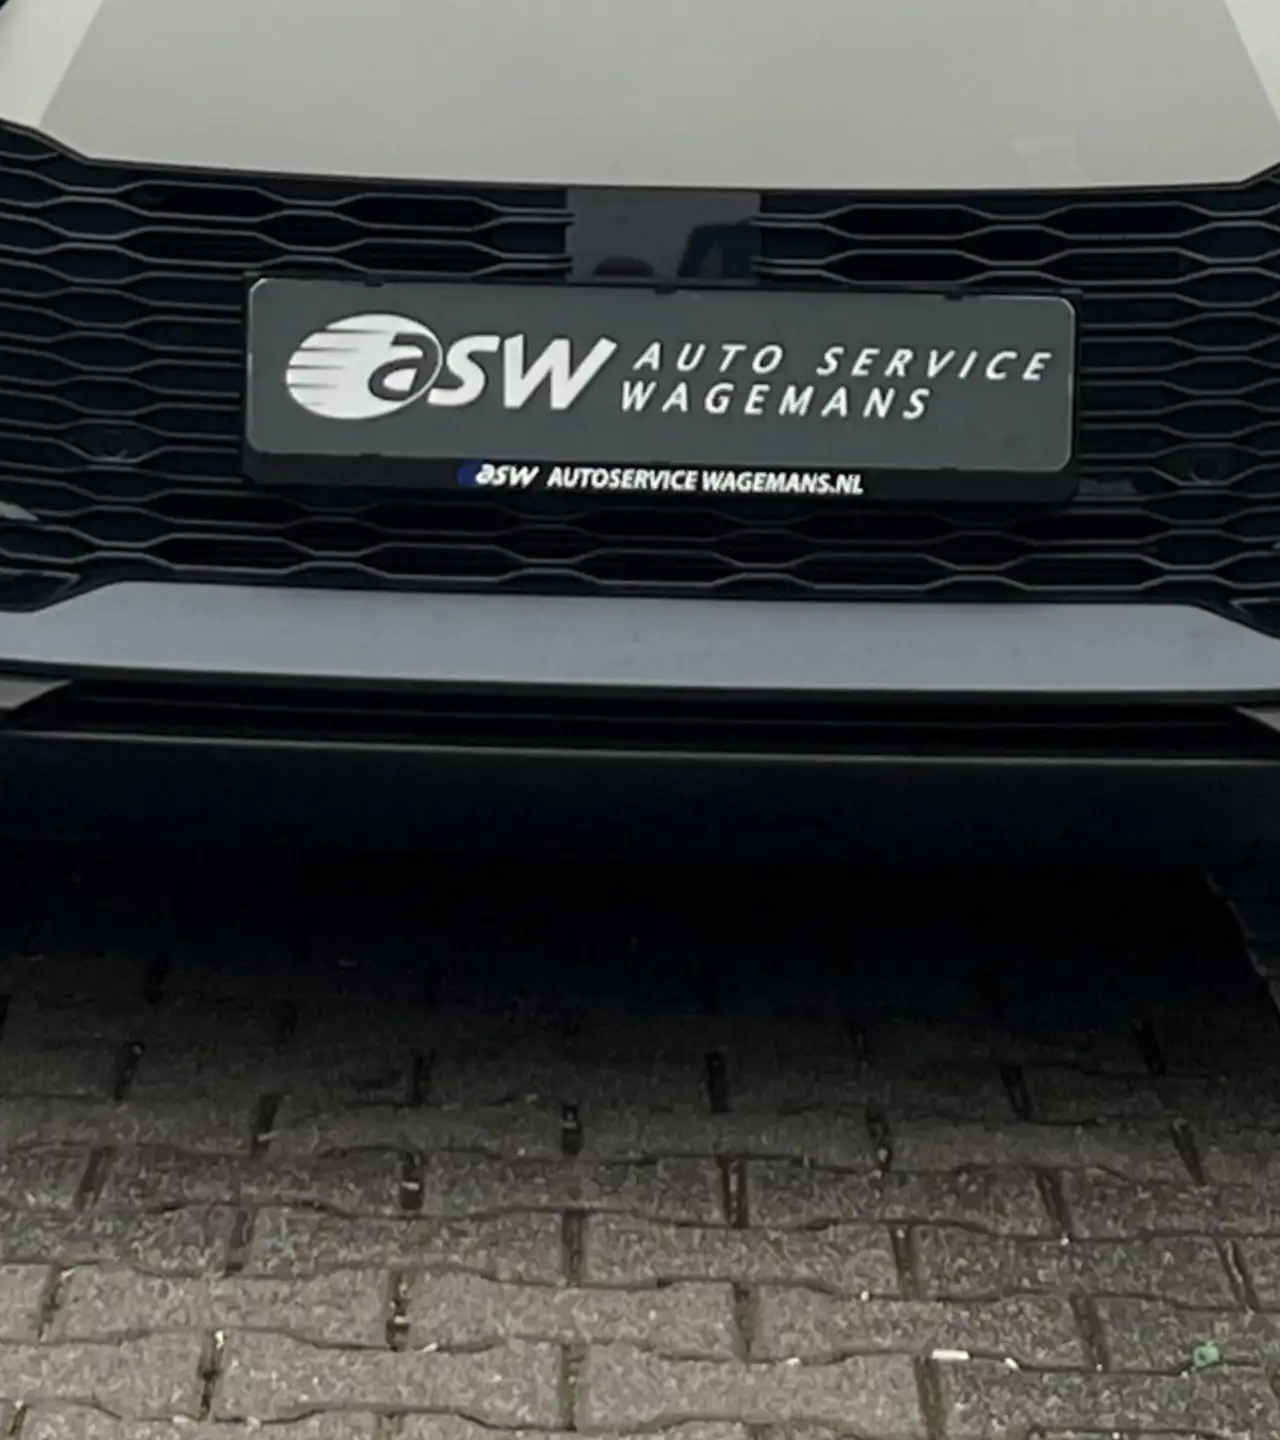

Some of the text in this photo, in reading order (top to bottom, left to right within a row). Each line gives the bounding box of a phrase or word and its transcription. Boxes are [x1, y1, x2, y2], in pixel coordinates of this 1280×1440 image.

[632, 341, 1053, 382] AUTO SERVICE
[621, 379, 931, 420] WAGEMANS
[545, 466, 700, 492] AUTOSERVICE
[701, 469, 865, 495] WAGEMANS.NL
